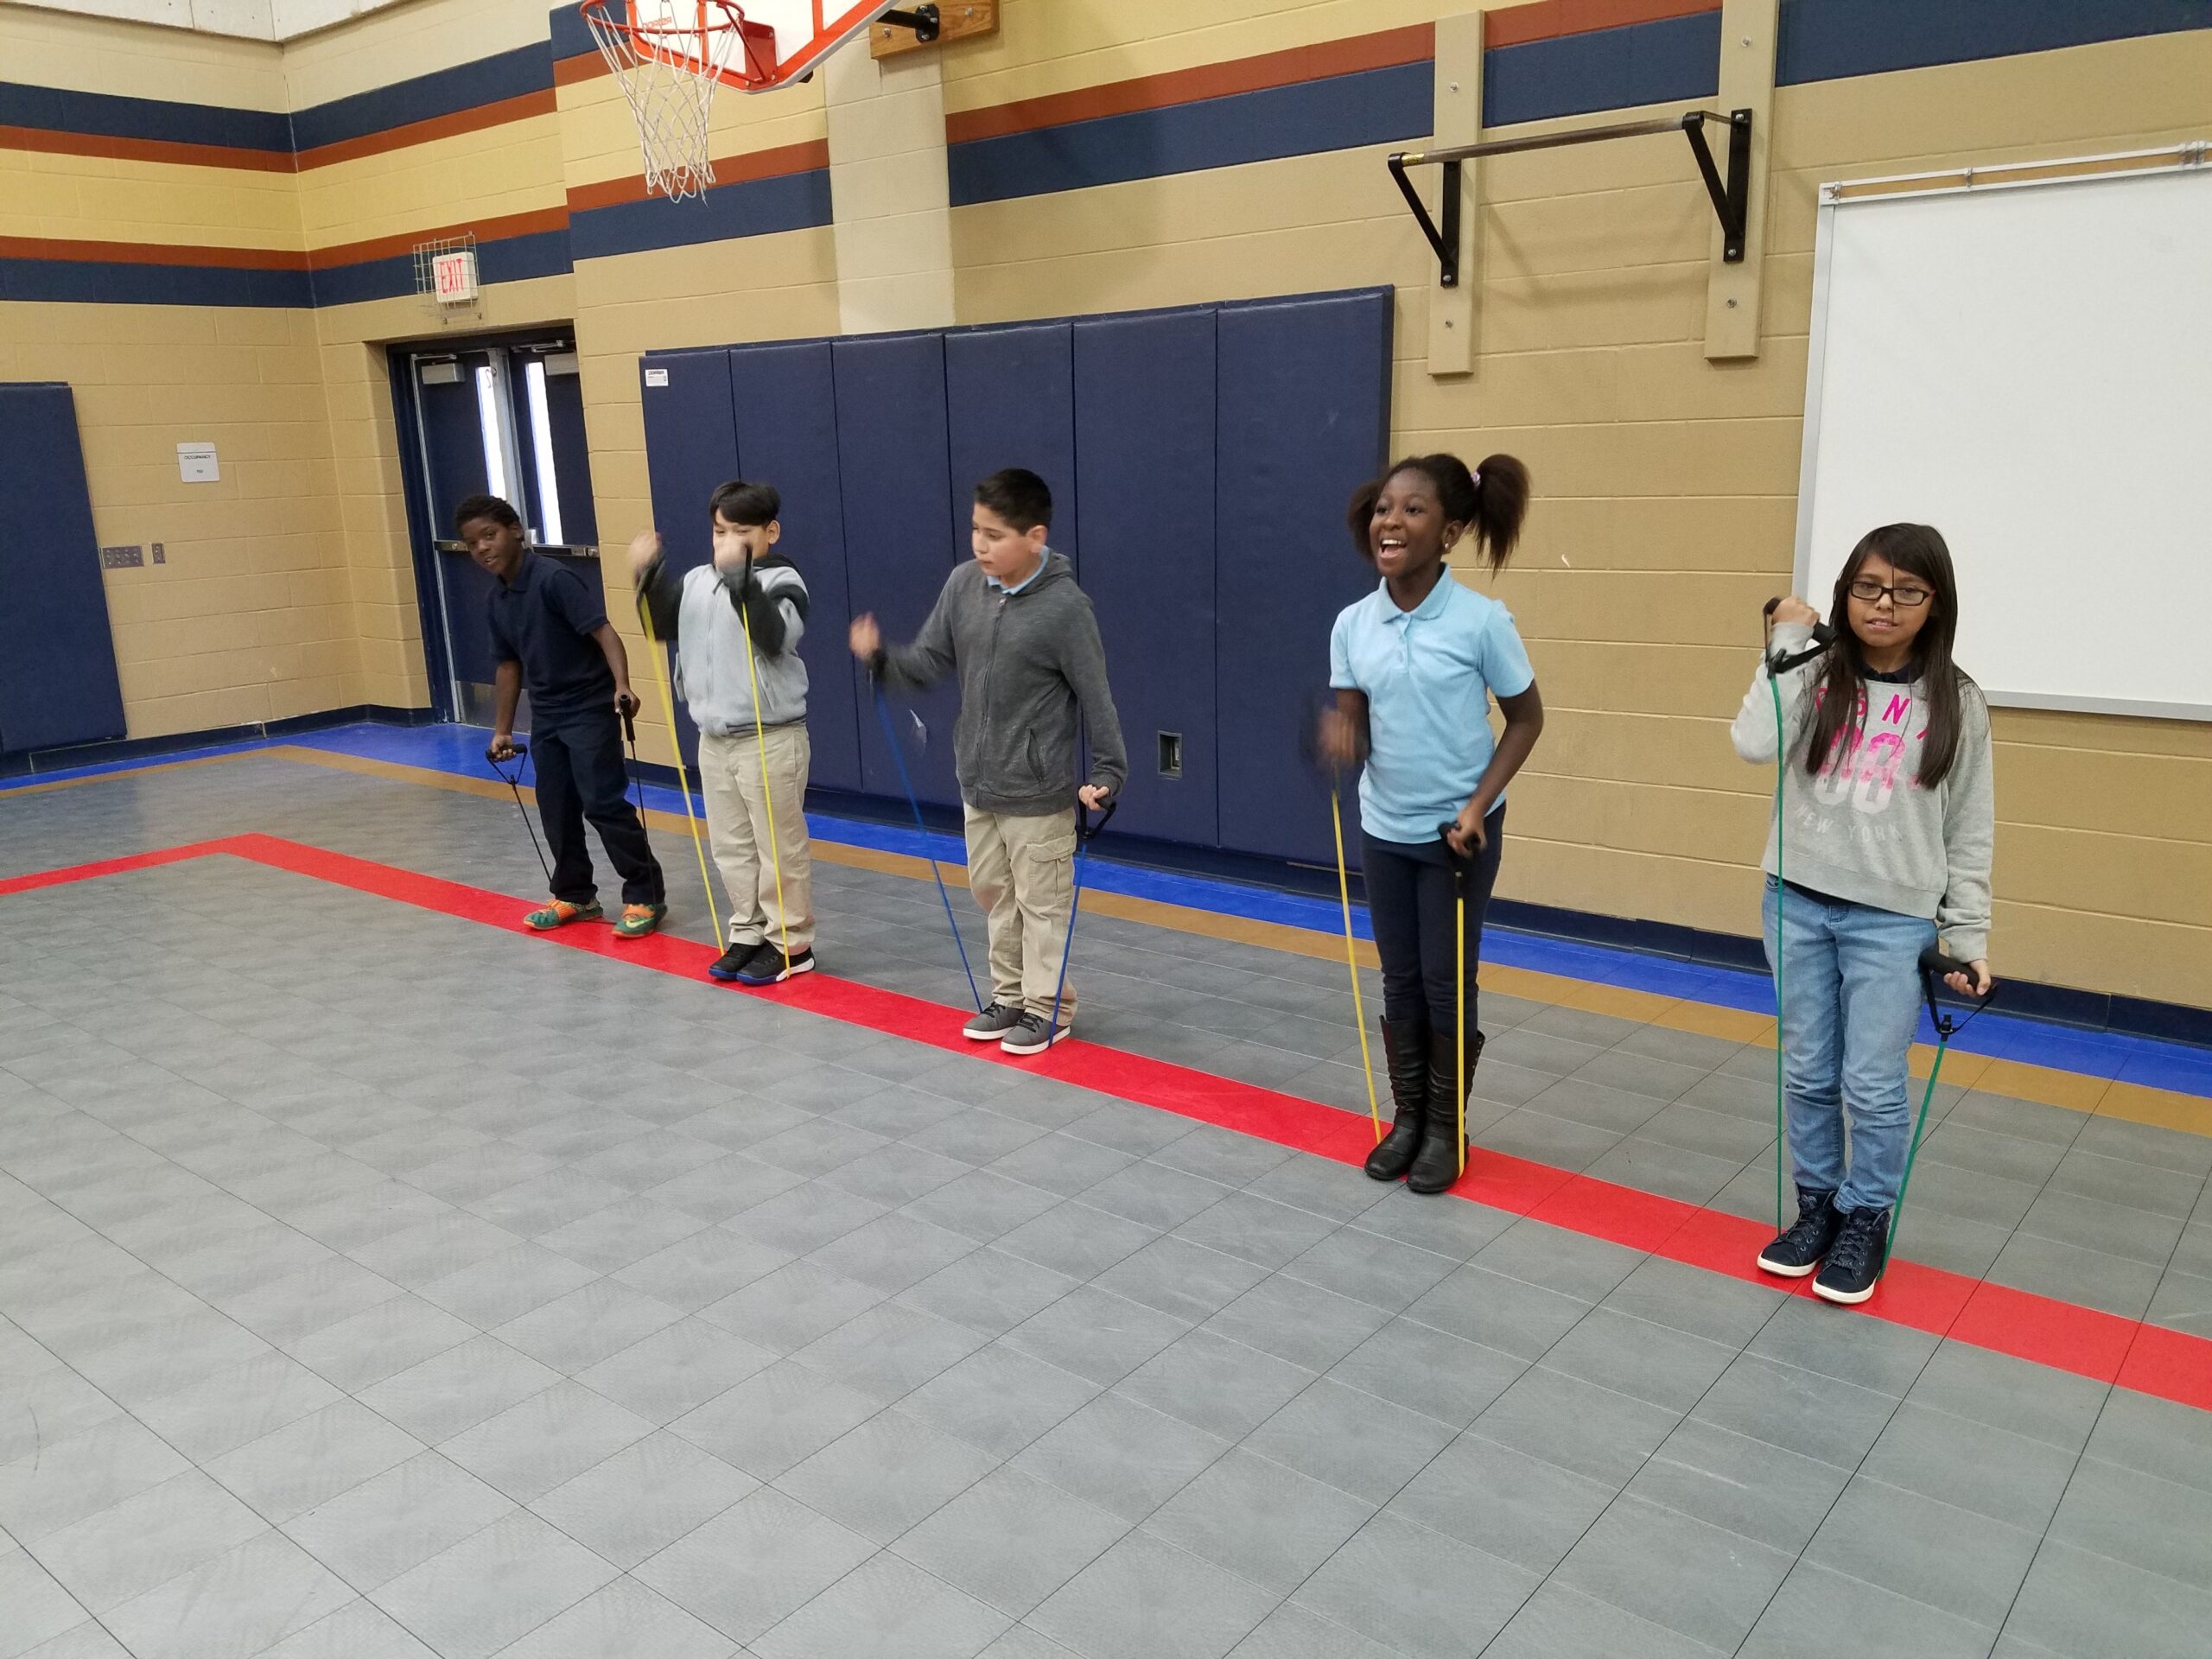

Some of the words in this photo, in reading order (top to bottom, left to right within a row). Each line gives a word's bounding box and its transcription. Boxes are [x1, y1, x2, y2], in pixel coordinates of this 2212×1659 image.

[438, 258, 465, 294] EXIT
[1795, 804, 1834, 834] NEW
[1847, 822, 1903, 842] YORK
